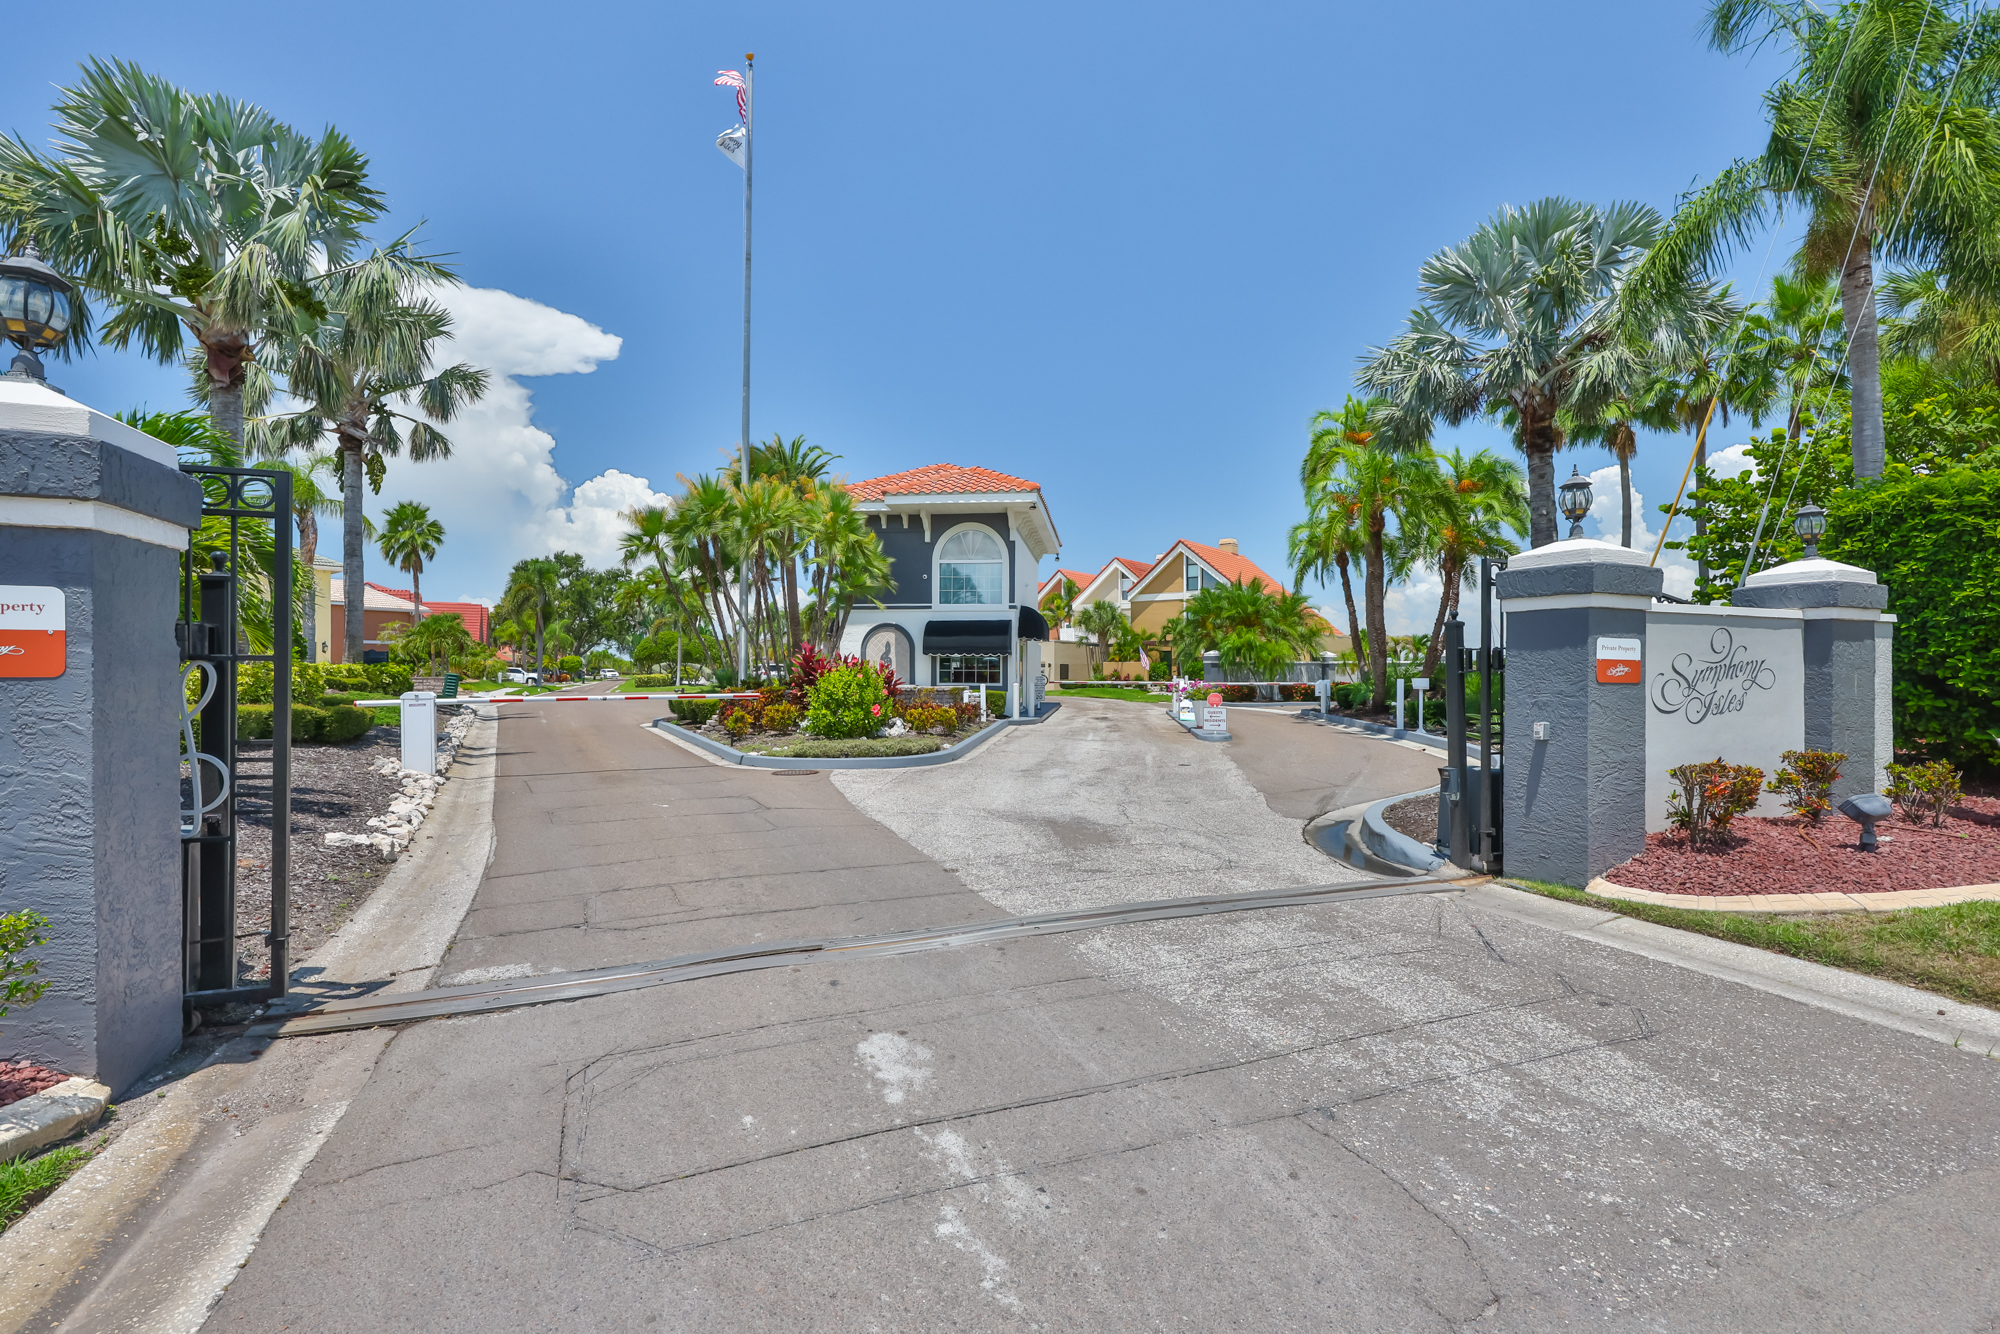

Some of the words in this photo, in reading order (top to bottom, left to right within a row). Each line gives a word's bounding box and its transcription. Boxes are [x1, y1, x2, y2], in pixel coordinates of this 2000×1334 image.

[1618, 645, 1636, 653] Property
[1650, 627, 1776, 715] Symphony
[1685, 687, 1748, 725] Isles
